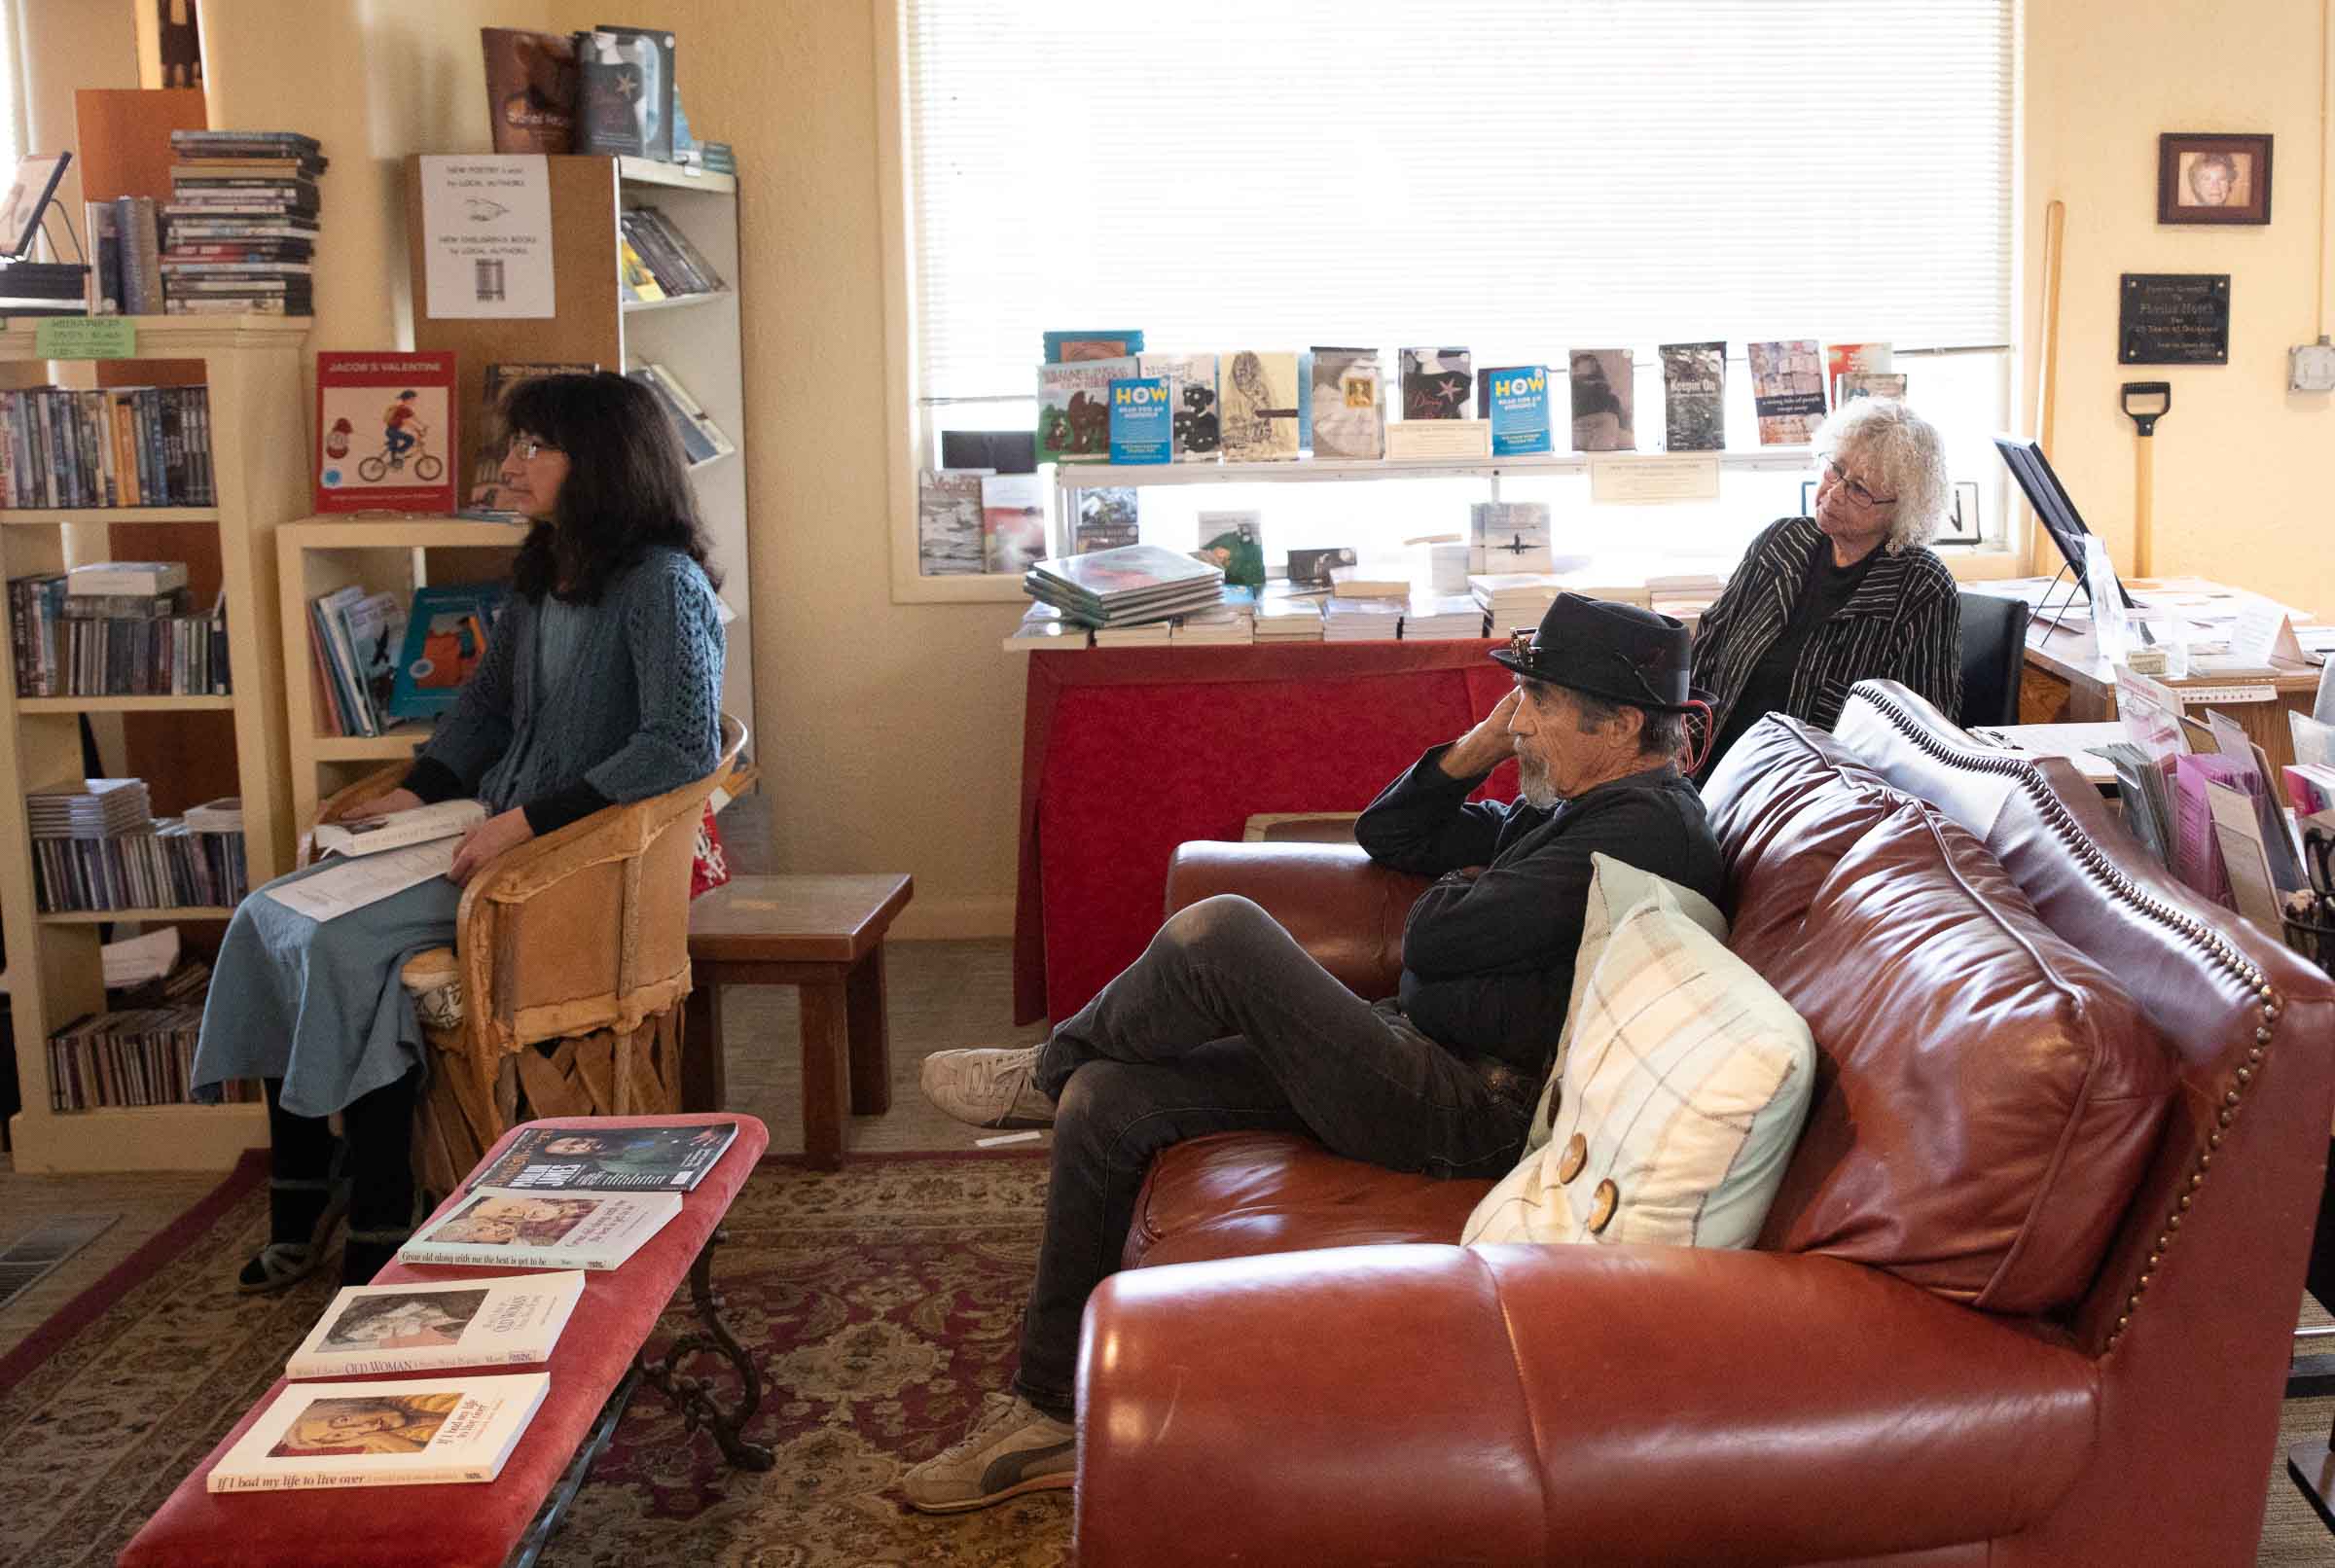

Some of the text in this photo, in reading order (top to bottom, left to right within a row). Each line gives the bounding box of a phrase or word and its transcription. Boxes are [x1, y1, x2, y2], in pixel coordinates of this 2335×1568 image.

[329, 362, 441, 373] JACOB'S VALENTINE
[1495, 376, 1545, 397] HOW
[1116, 387, 1168, 405] HOW
[402, 1252, 420, 1261] Grow
[435, 1253, 452, 1264] along
[455, 1254, 470, 1263] with
[484, 1254, 493, 1263] the
[496, 1255, 509, 1264] best
[511, 1256, 516, 1265] is
[518, 1257, 528, 1266] yet
[530, 1256, 537, 1265] to
[539, 1257, 547, 1265] be
[343, 1362, 369, 1374] OLD
[370, 1360, 413, 1372] WOMAN
[217, 1478, 229, 1490] If
[230, 1478, 234, 1487] I
[238, 1477, 258, 1488] had
[263, 1479, 280, 1490] my
[283, 1474, 301, 1488] life
[304, 1475, 314, 1486] to
[317, 1473, 338, 1485] live
[339, 1476, 366, 1485] over
